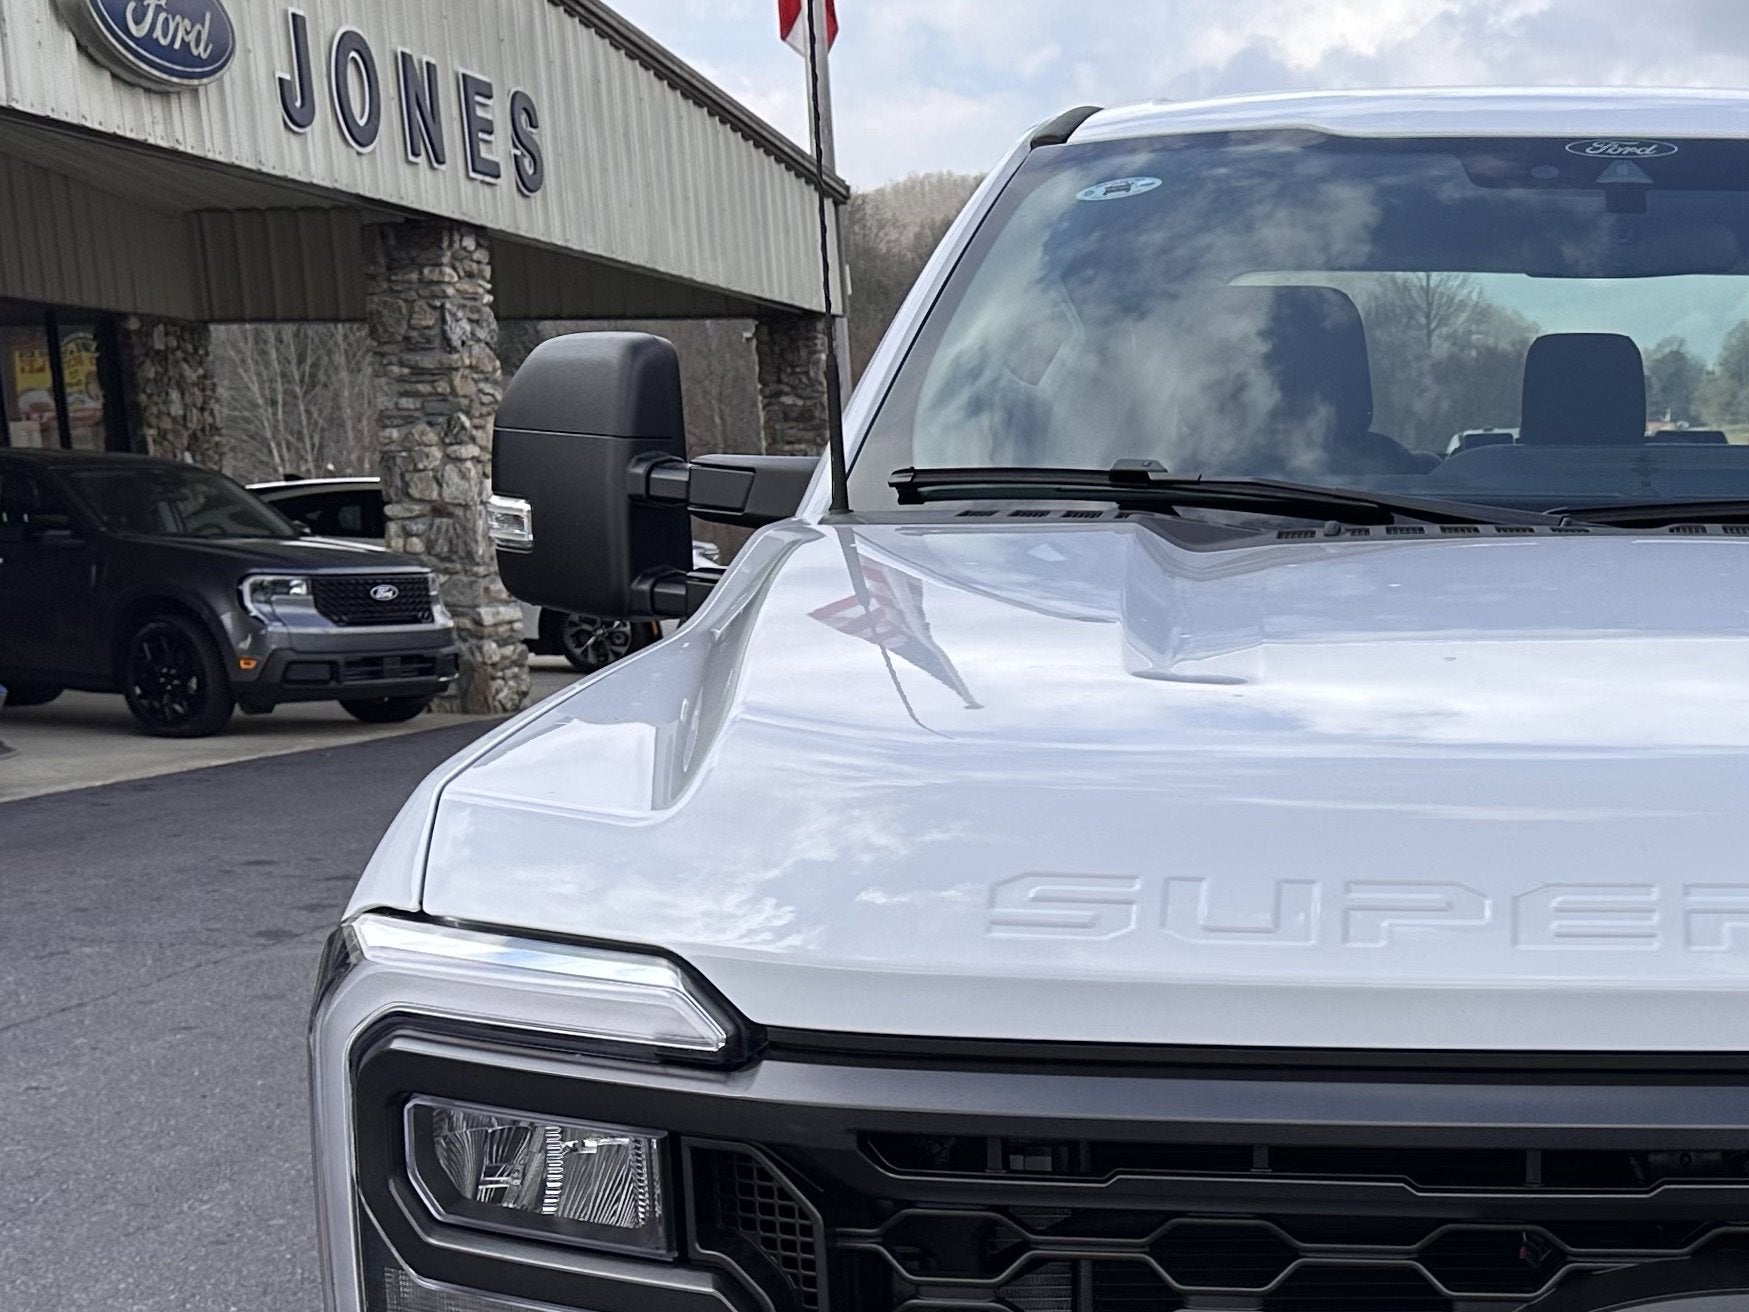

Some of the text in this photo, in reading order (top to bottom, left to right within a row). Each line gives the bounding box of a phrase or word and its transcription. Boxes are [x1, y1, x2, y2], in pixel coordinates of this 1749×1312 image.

[126, 0, 213, 60] Ford
[275, 8, 544, 197] JONES
[1585, 140, 1658, 155] Ford
